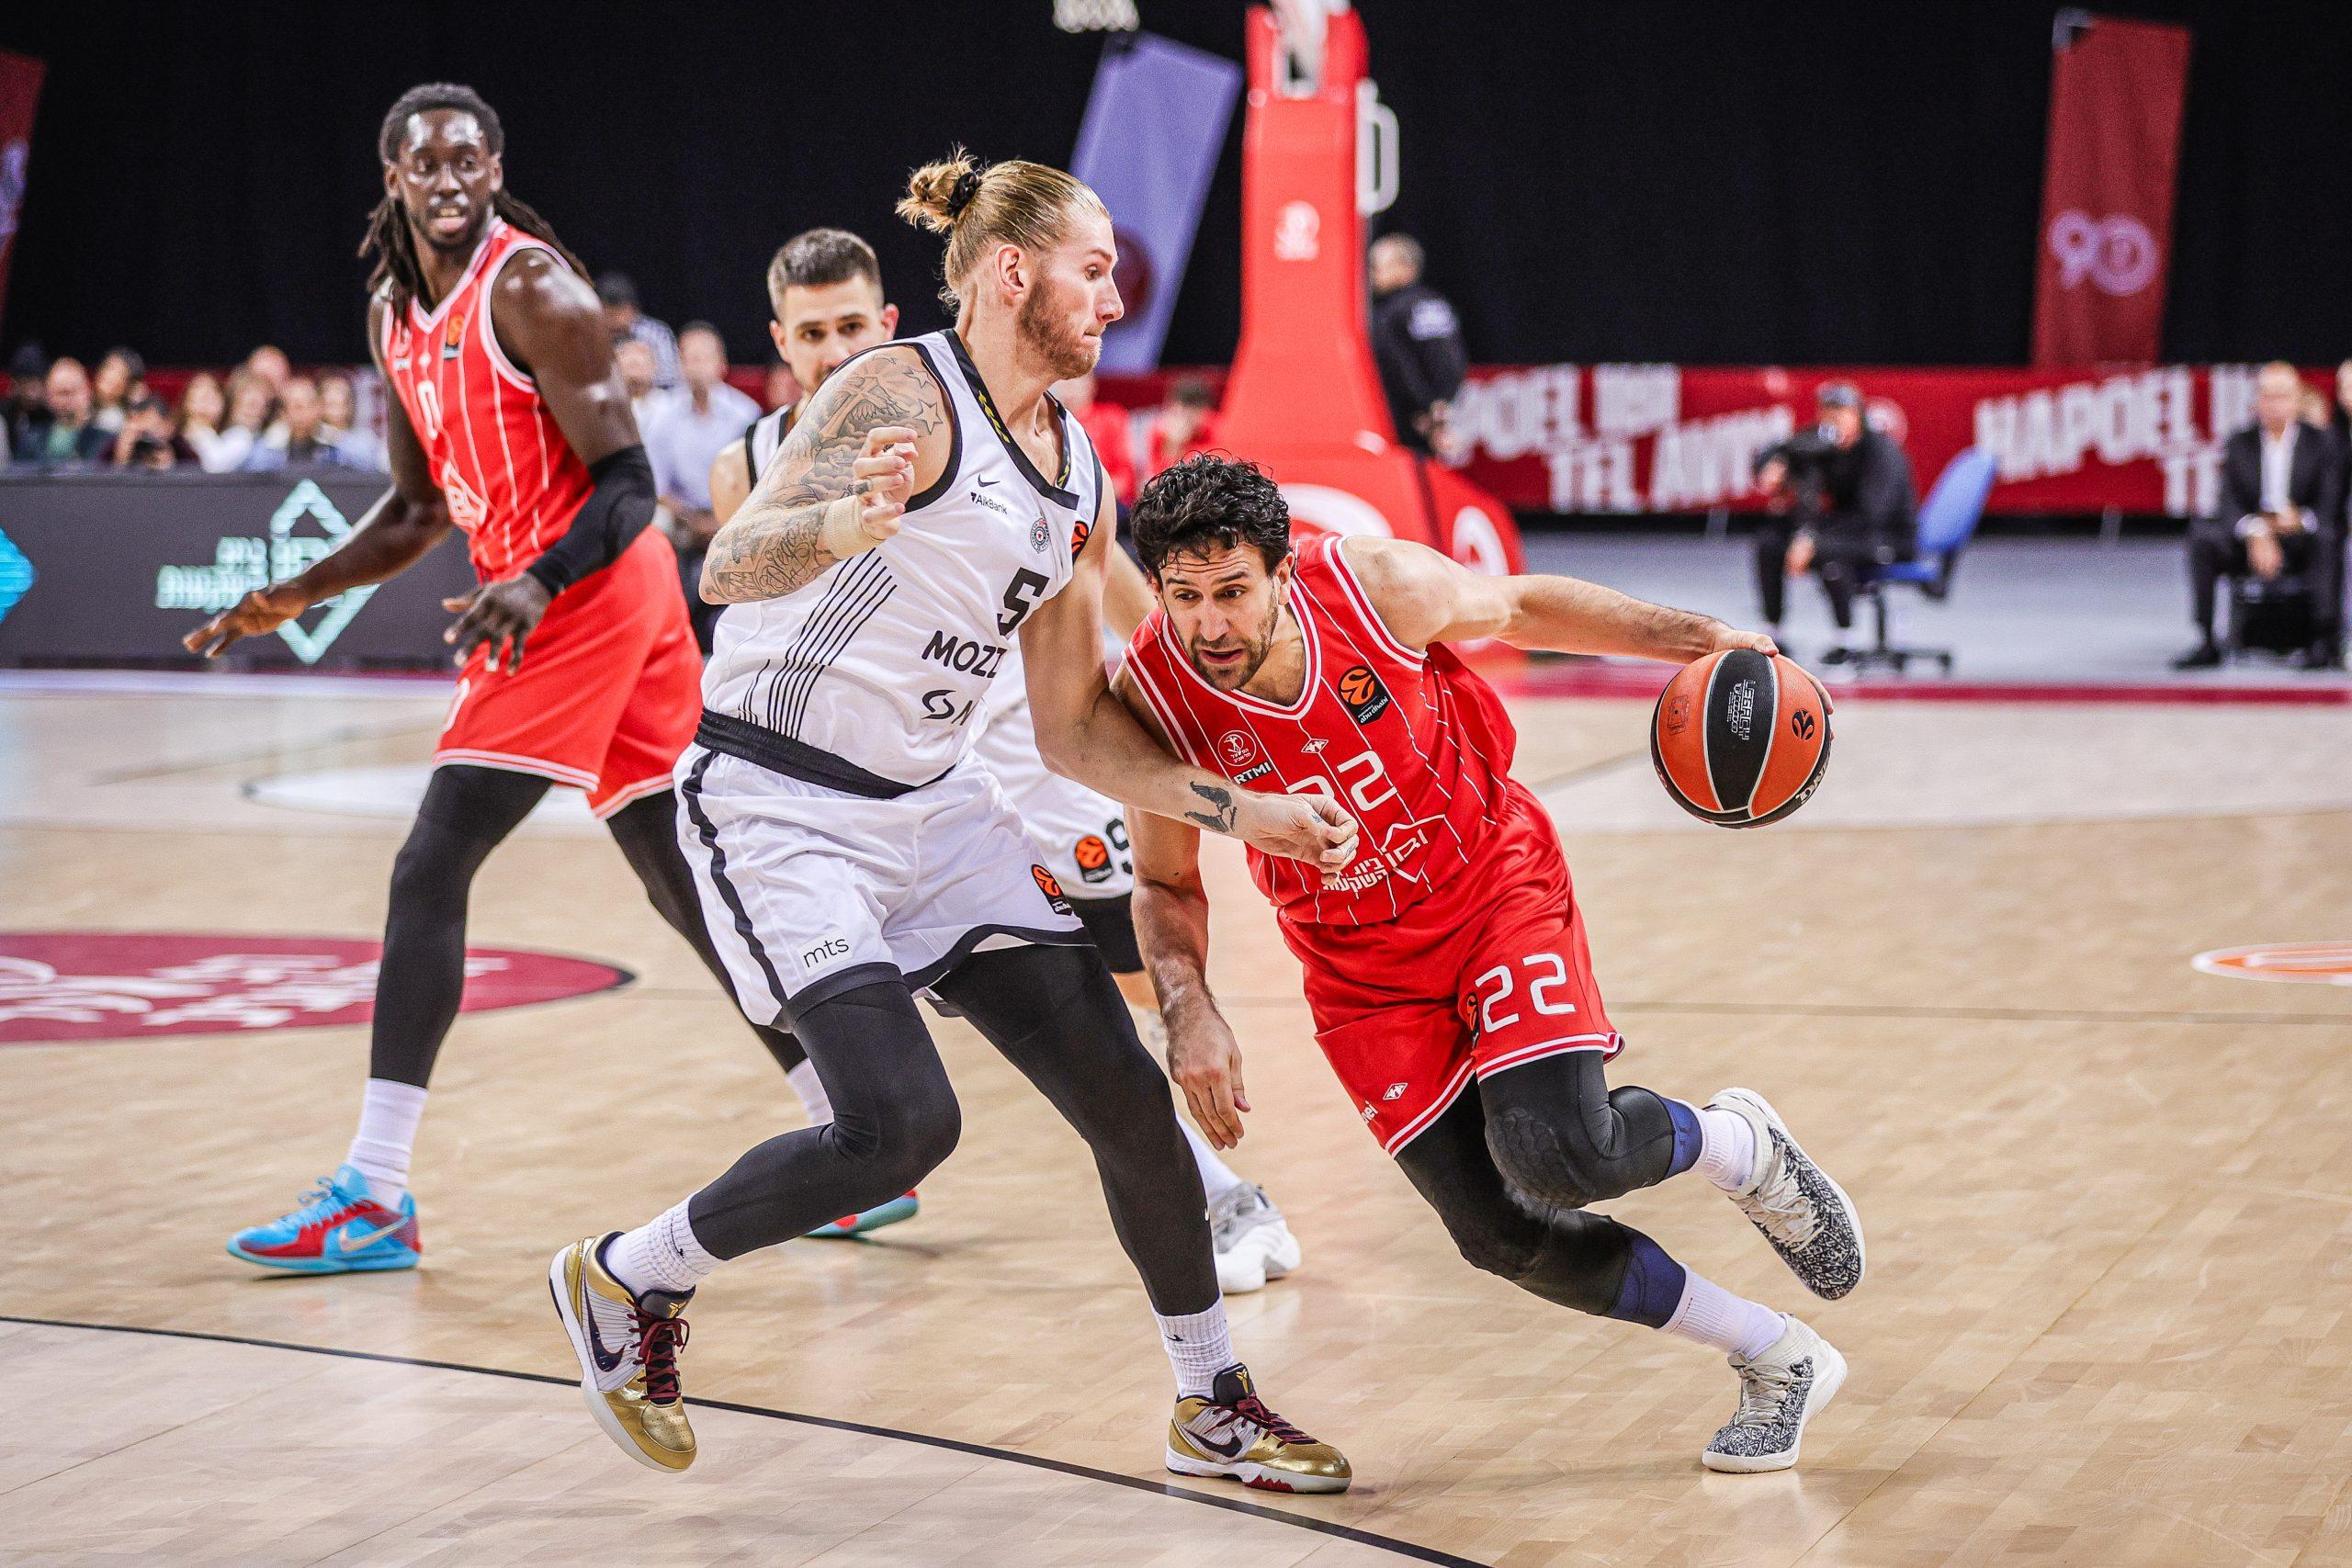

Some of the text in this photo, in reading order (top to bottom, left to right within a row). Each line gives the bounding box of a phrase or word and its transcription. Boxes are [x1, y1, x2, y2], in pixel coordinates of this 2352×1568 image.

[1445, 363, 1594, 471] POEL
[976, 494, 1008, 515] AikBank
[996, 567, 1050, 639] 5
[802, 938, 850, 968] mts
[1475, 952, 1577, 1033] 22
